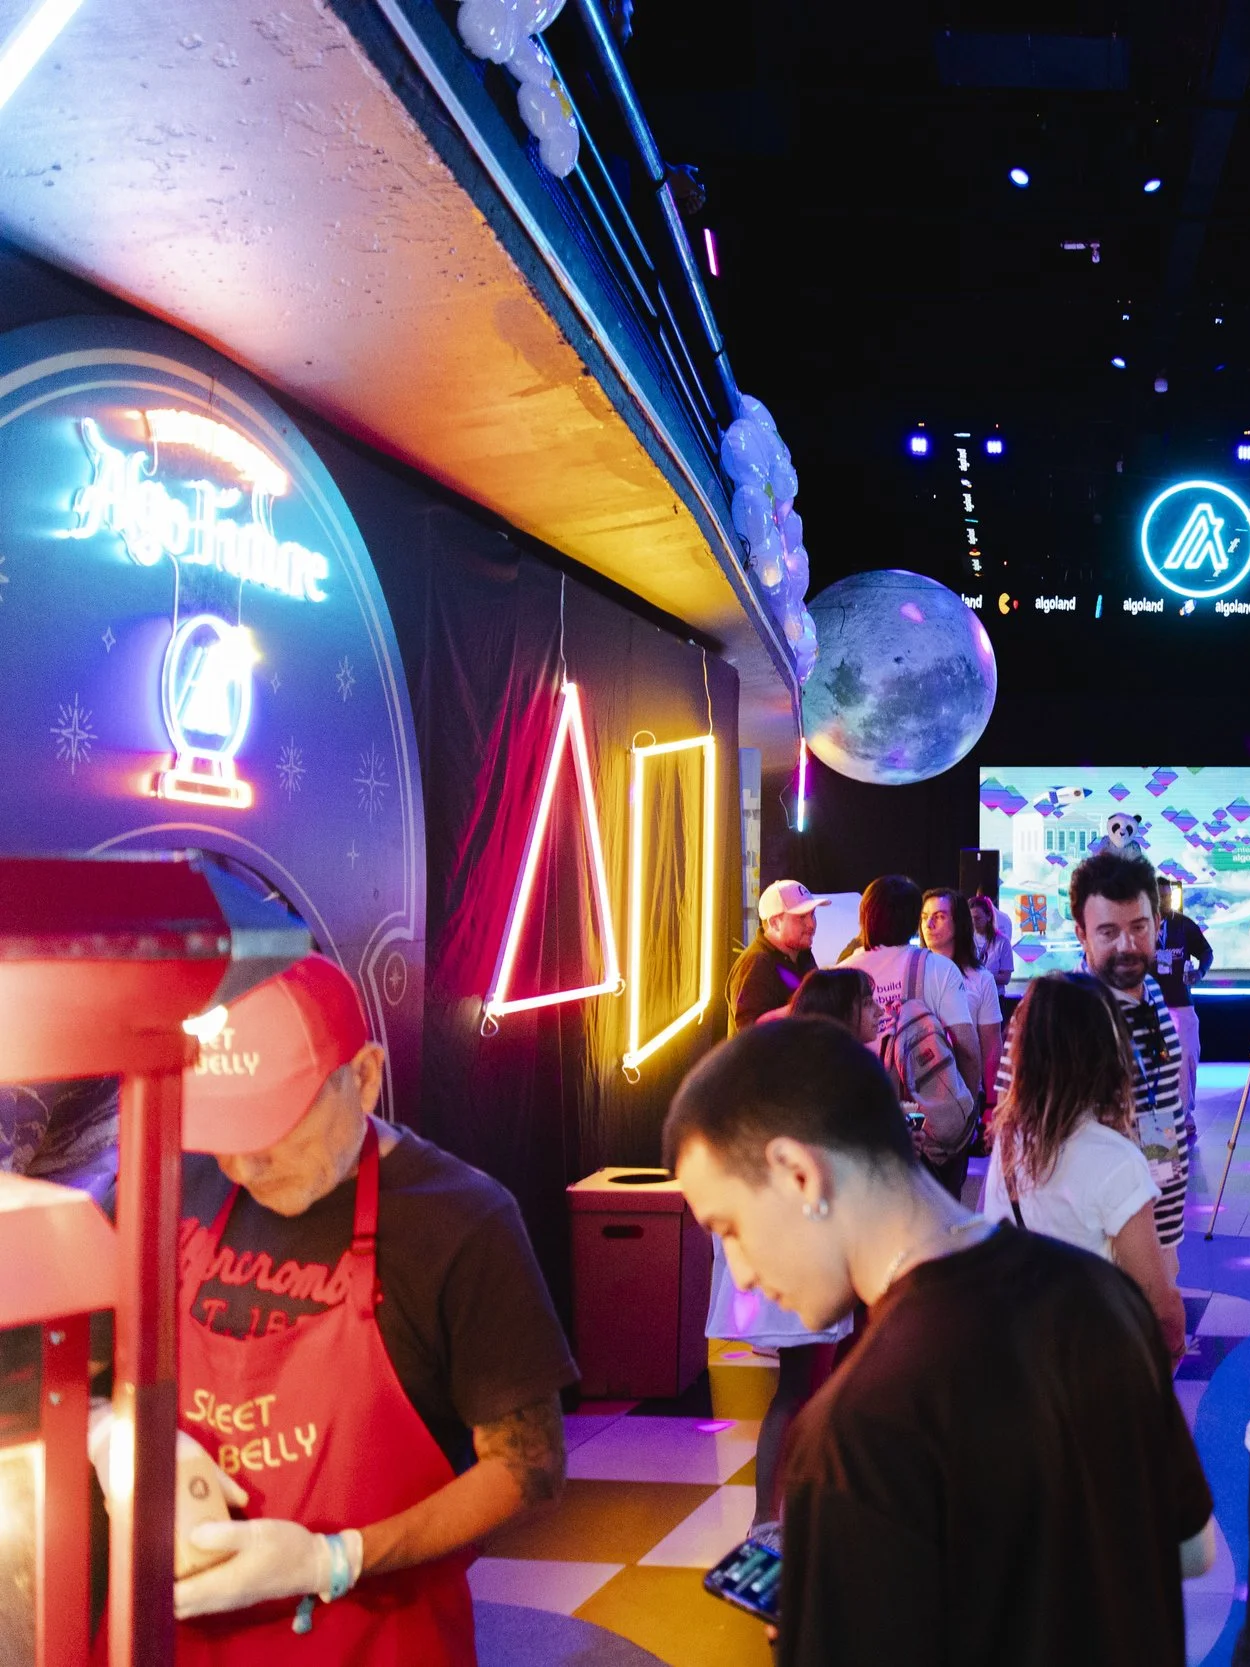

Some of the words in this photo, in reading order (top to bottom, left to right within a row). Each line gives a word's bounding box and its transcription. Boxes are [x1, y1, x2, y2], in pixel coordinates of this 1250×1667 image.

[1035, 595, 1076, 613] algoland
[1123, 597, 1163, 615] algoland
[877, 981, 902, 993] build
[219, 1422, 317, 1475] BELLY
